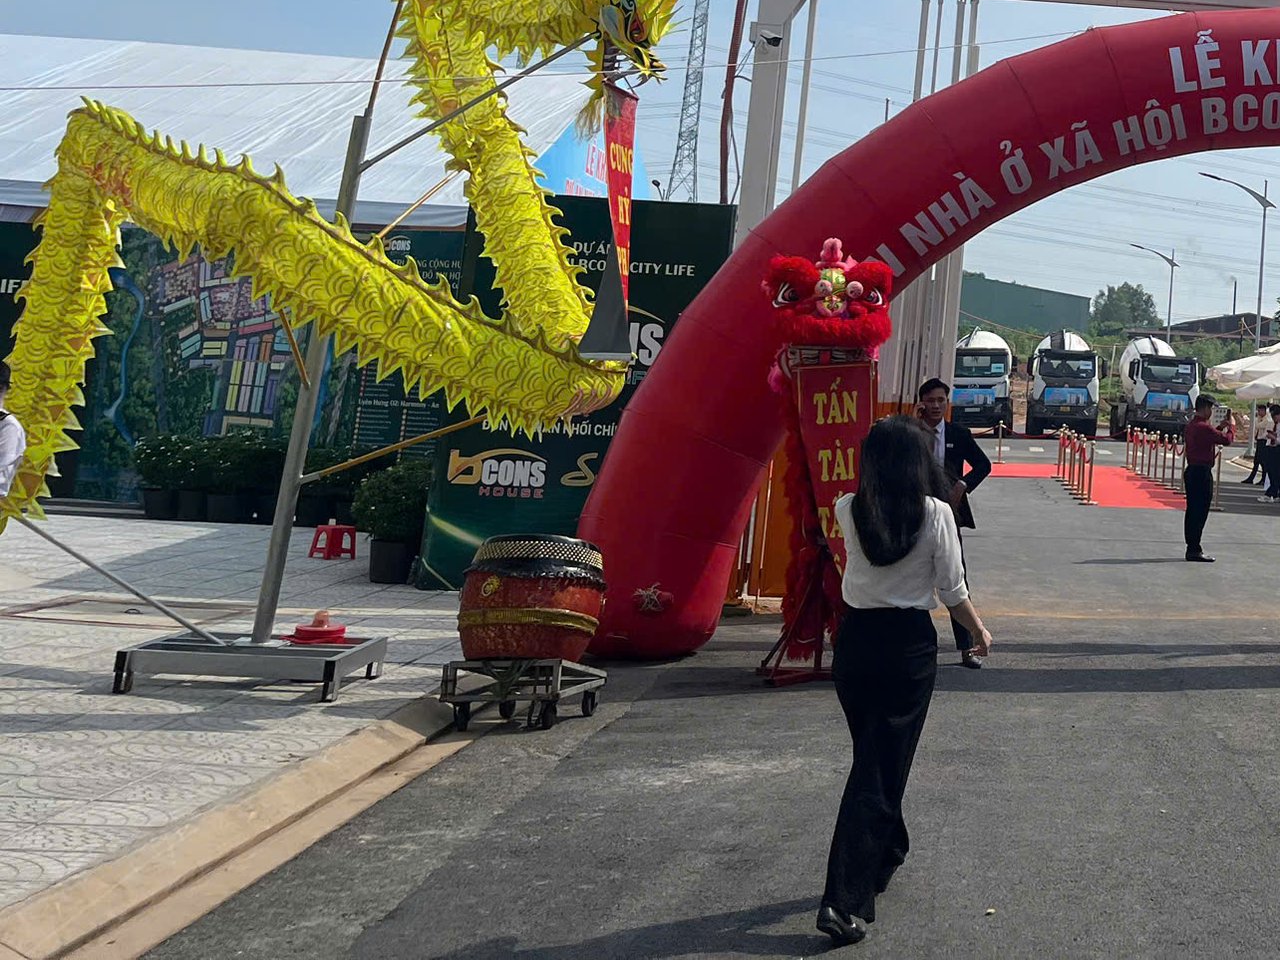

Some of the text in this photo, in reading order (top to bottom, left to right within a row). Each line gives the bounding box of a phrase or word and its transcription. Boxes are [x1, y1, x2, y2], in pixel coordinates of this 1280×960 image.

[1169, 28, 1226, 94] LỄ
[898, 171, 996, 257] NHÀ
[999, 140, 1033, 195] Ở
[1038, 120, 1104, 181] XÃ
[1112, 98, 1187, 156] HỘI
[629, 261, 662, 275] CITY
[665, 264, 696, 277] LIFE
[813, 376, 858, 426] TẤN
[818, 438, 855, 482] TÀI
[479, 486, 545, 499] HOUSE
